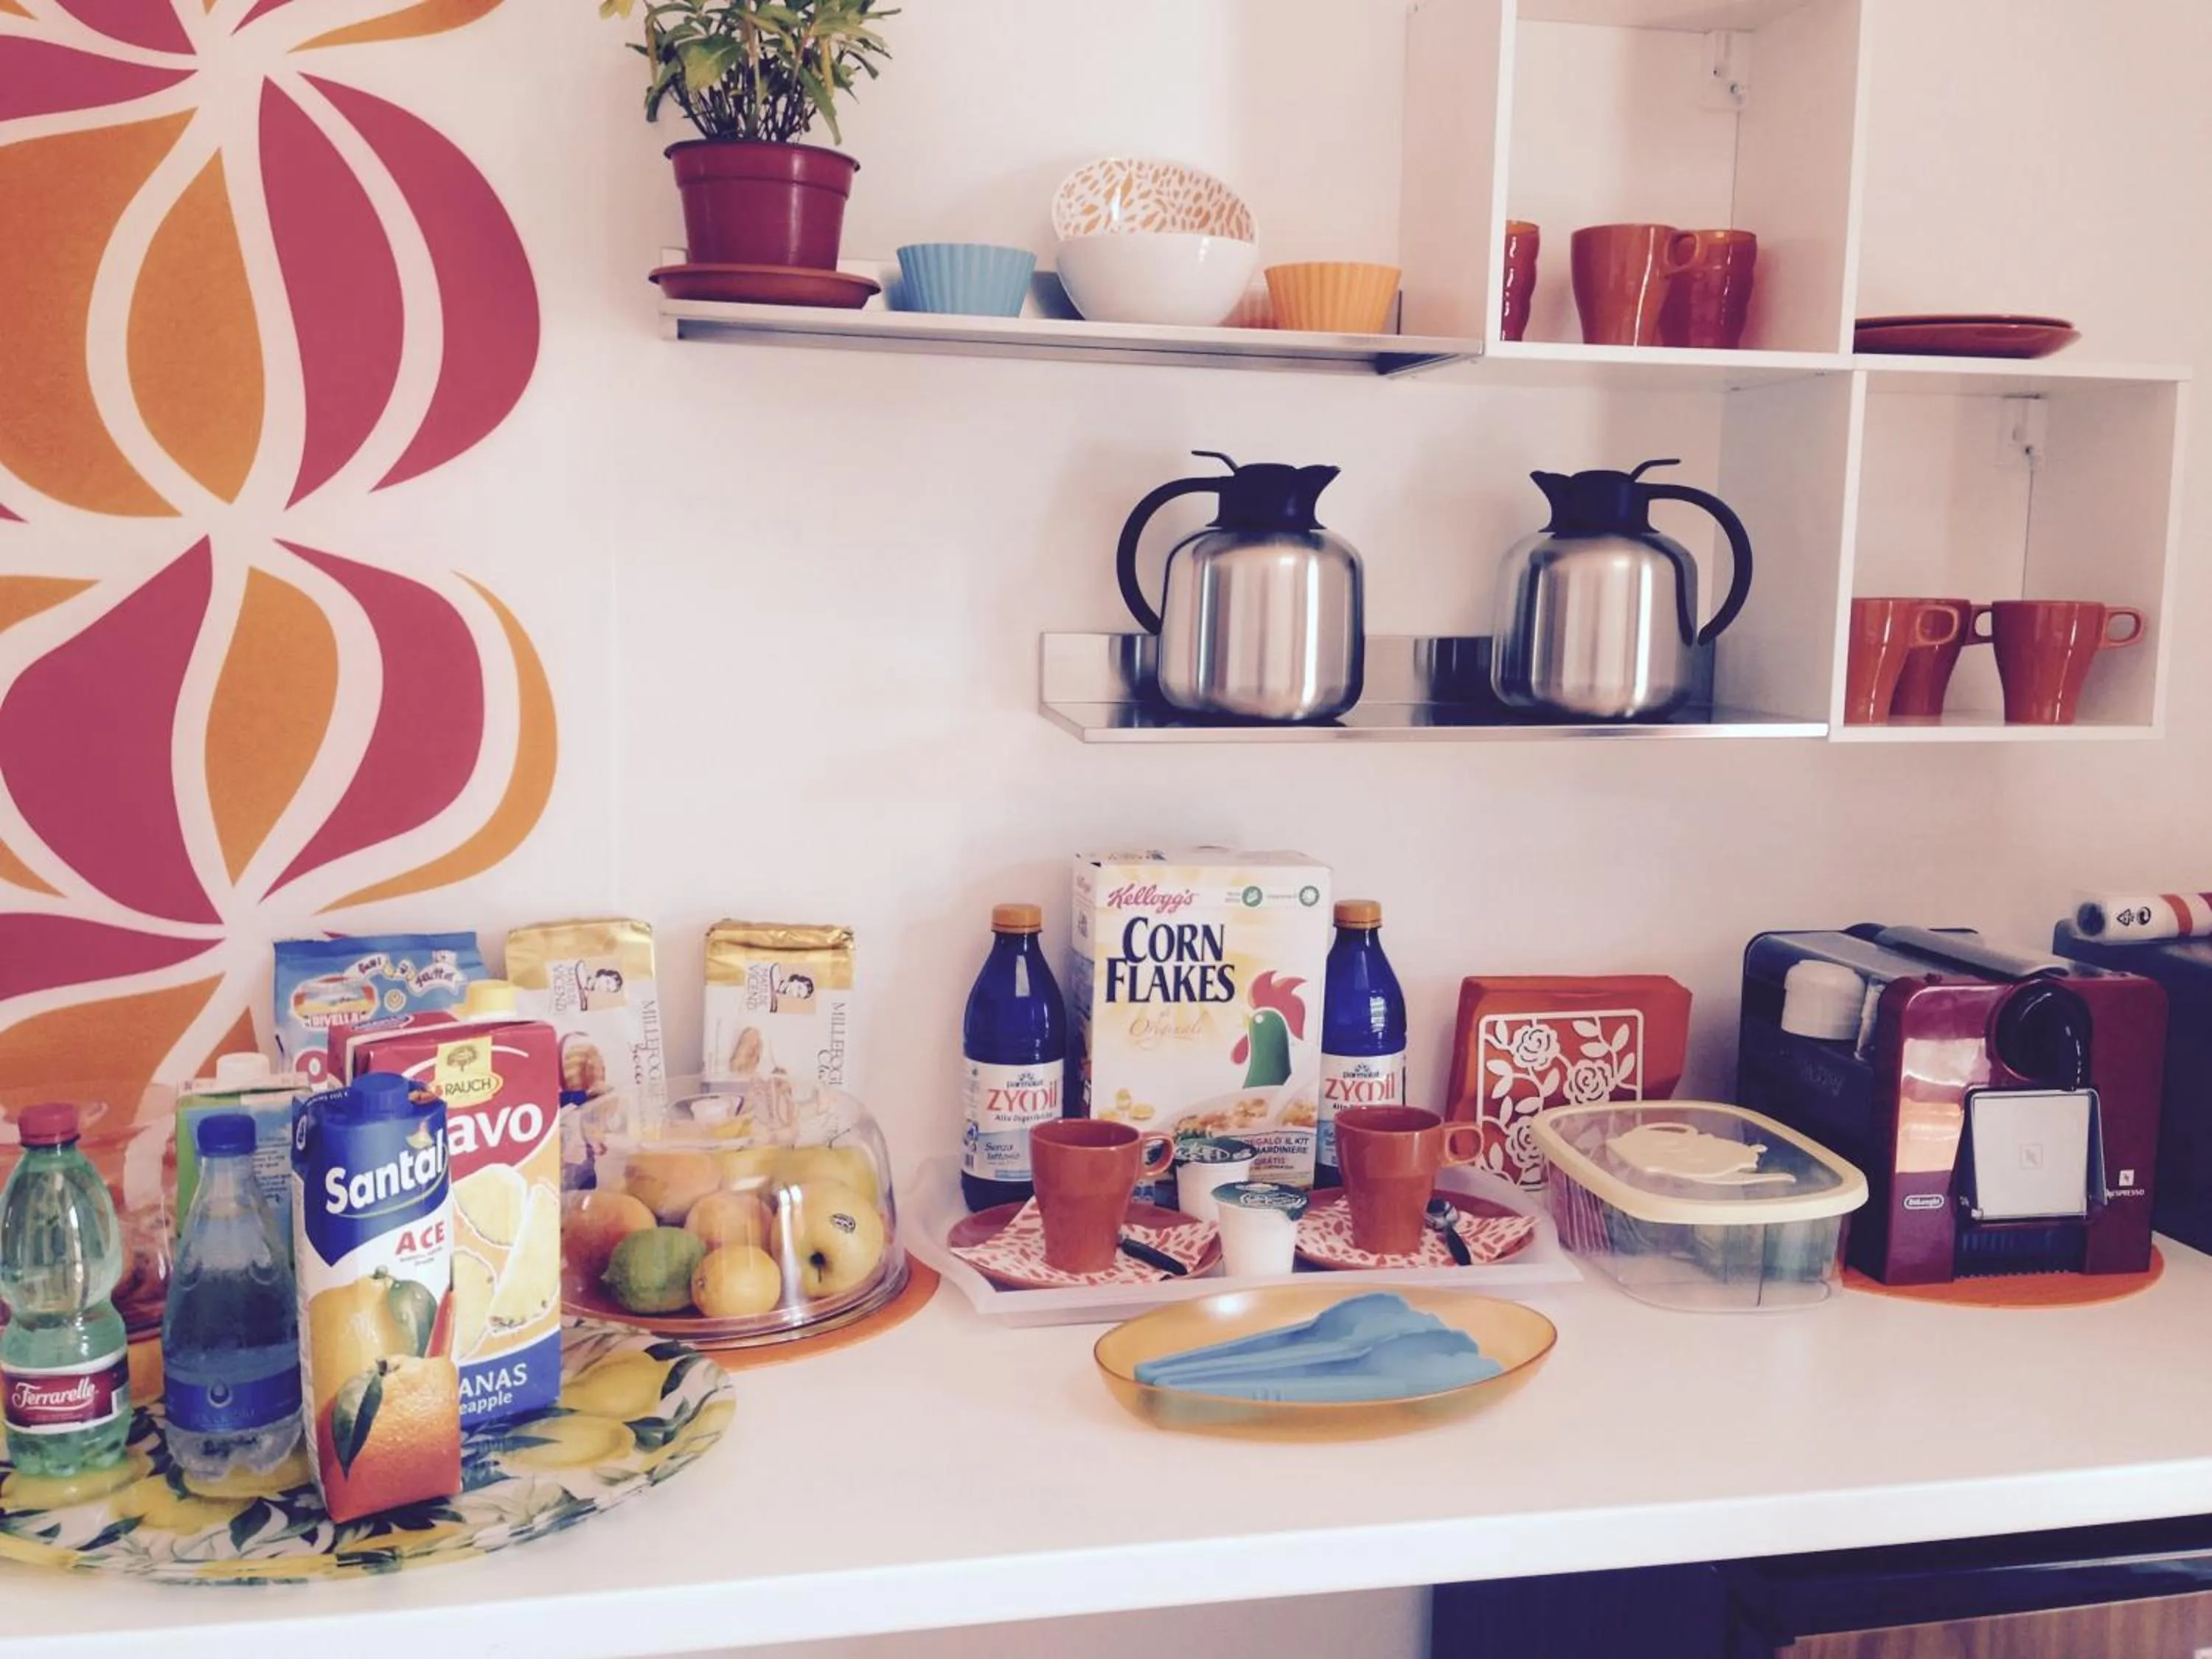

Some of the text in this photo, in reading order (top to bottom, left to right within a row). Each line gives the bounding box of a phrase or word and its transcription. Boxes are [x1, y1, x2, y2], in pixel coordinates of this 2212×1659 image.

[1107, 883, 1200, 914] Kellogg's
[1122, 917, 1225, 963] CORN
[1106, 957, 1235, 1003] FLAKES
[445, 1078, 491, 1095] RAUCH
[447, 1103, 543, 1155] avo
[394, 1221, 445, 1256] ACE
[12, 1376, 95, 1409] Ferrarelle
[459, 1363, 528, 1397] ANAS
[459, 1391, 513, 1413] eapple
